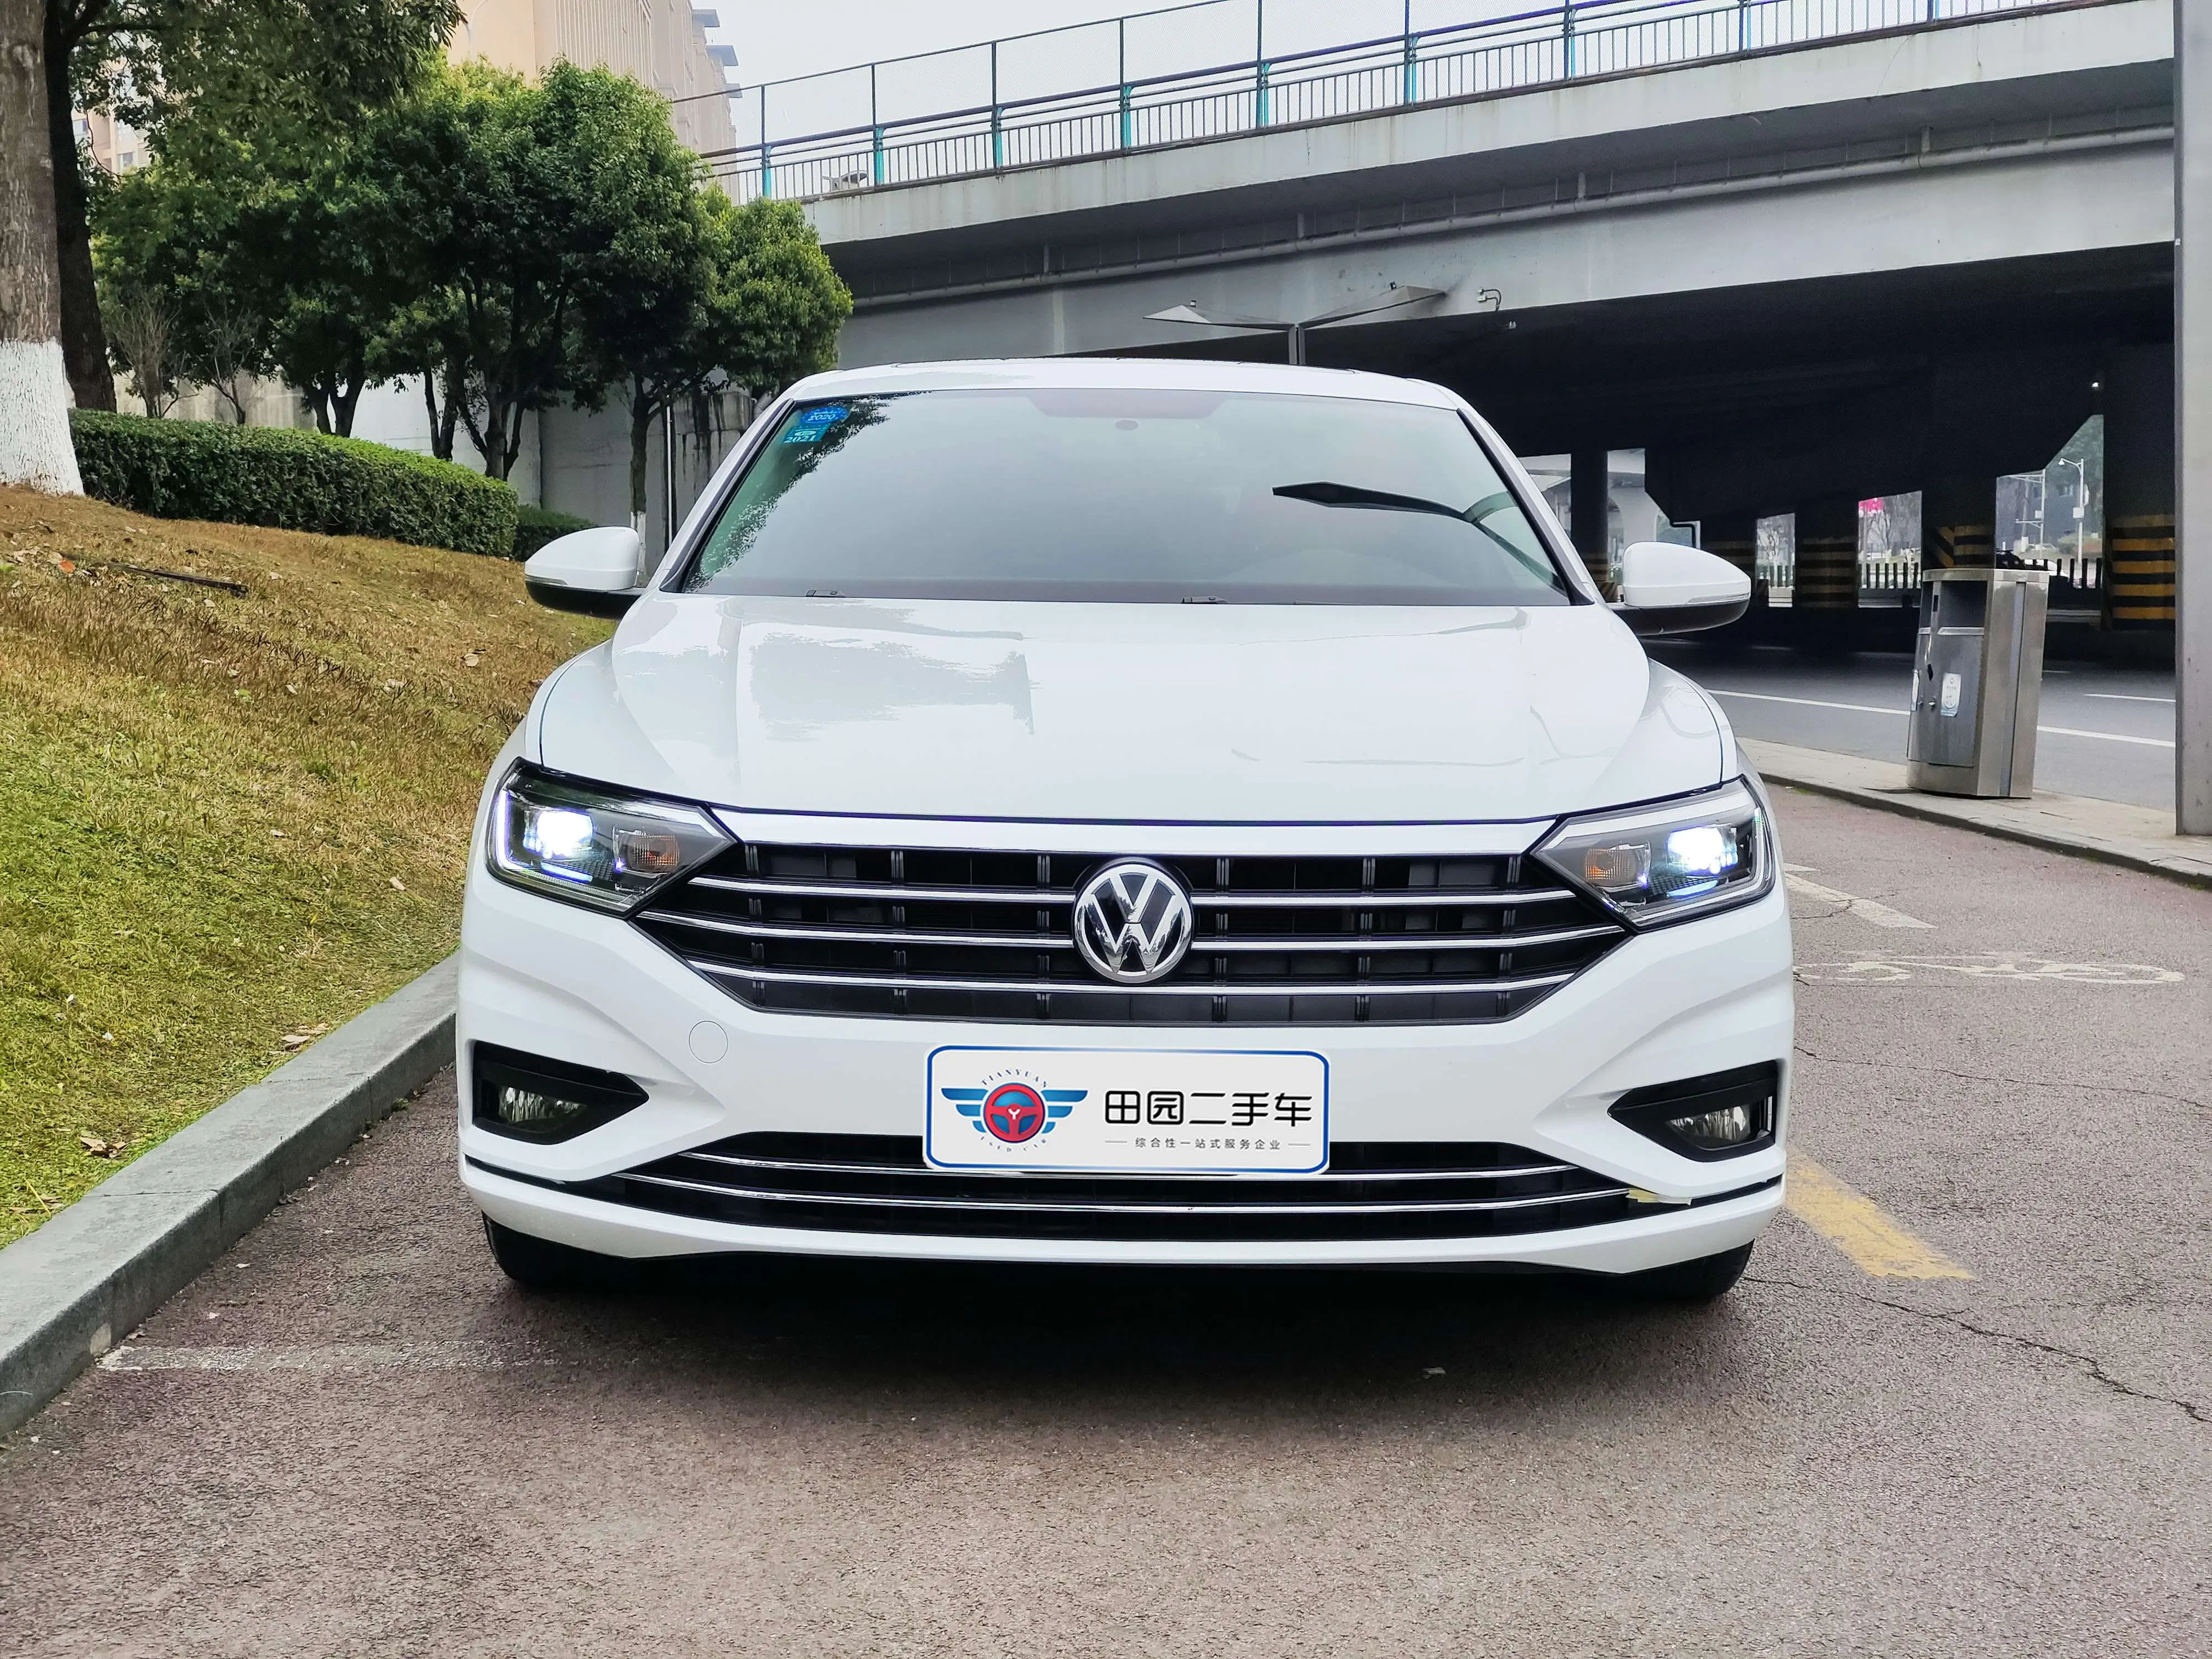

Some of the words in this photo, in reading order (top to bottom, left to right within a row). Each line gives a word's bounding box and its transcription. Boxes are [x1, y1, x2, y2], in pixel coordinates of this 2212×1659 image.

[783, 435, 817, 443] 2021
[1104, 1090, 1313, 1128] 田园二手车
[1134, 1137, 1281, 1150] 综合性一站式服务企业
